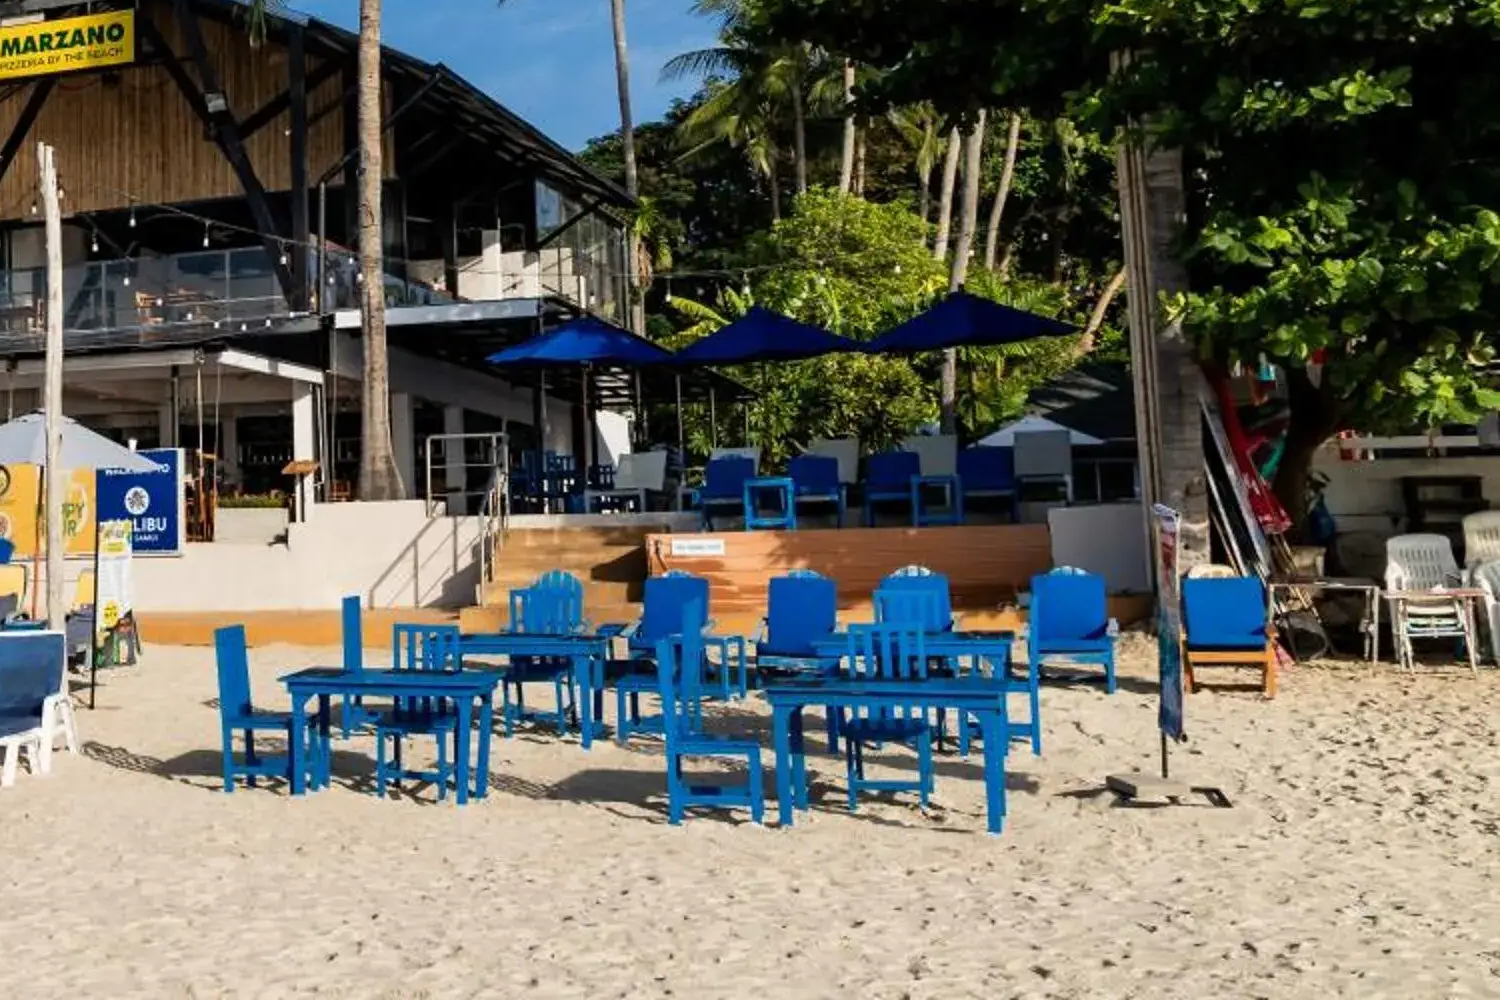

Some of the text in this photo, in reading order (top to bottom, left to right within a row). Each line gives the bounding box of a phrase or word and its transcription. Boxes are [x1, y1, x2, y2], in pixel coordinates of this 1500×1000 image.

[1, 23, 125, 57] MARZANO
[0, 47, 124, 71] PIZZERIA BY THE BEACH
